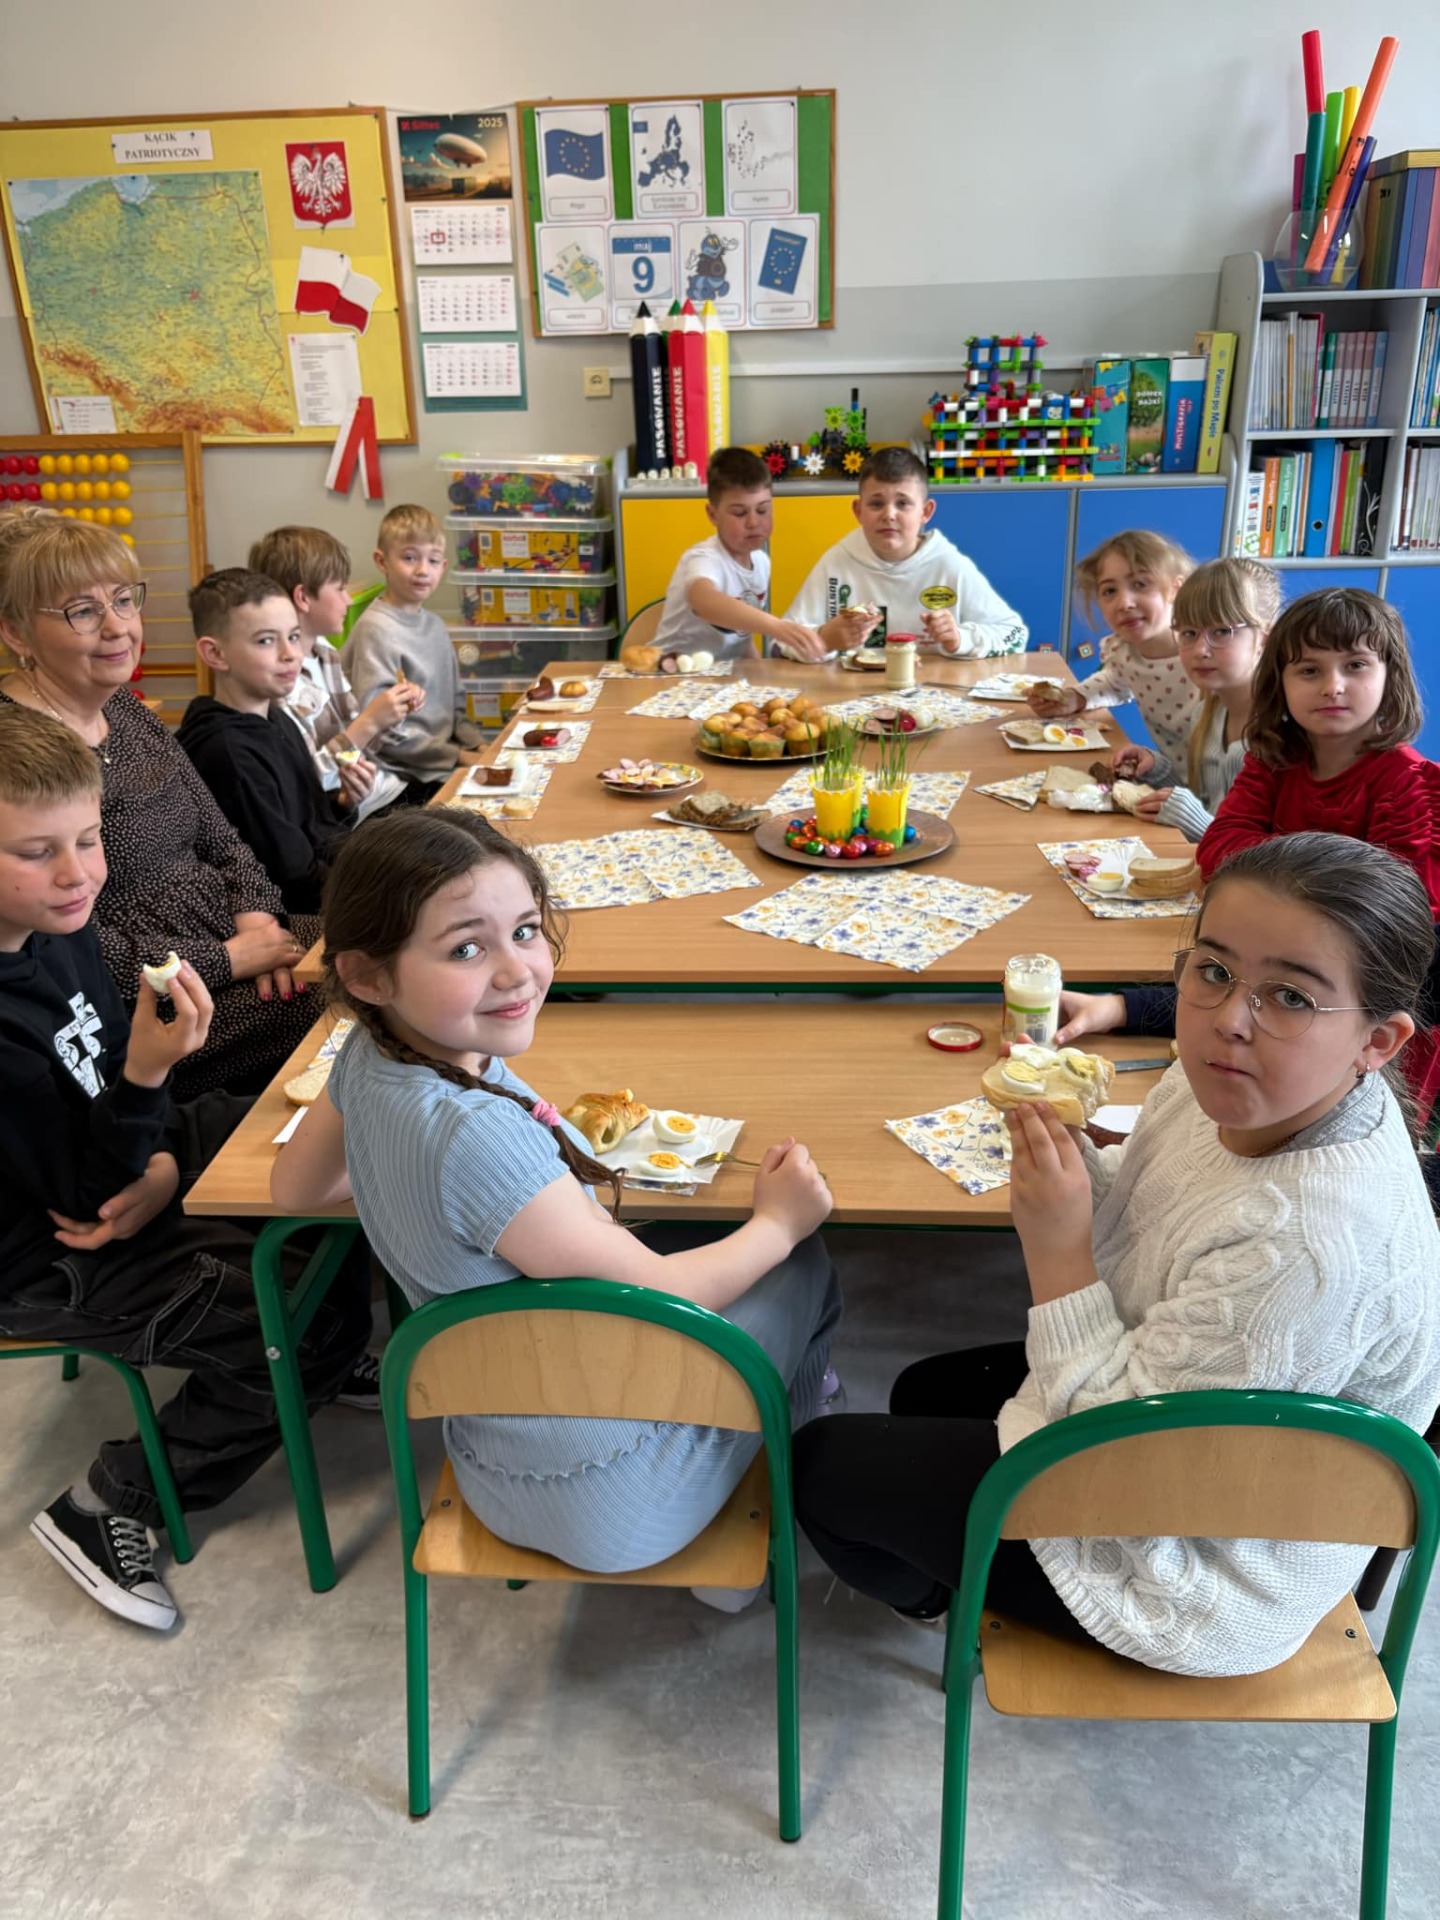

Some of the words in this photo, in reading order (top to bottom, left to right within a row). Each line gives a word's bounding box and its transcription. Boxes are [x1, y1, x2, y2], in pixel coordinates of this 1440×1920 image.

[144, 133, 177, 143] KĄCIK
[477, 117, 503, 129] 2025
[125, 147, 200, 159] PATRIOTYCZNY
[631, 255, 655, 294] 9
[651, 366, 666, 459] PASOWANIE
[672, 366, 686, 459] PASOWANIE
[711, 366, 724, 450] ASOWANIE
